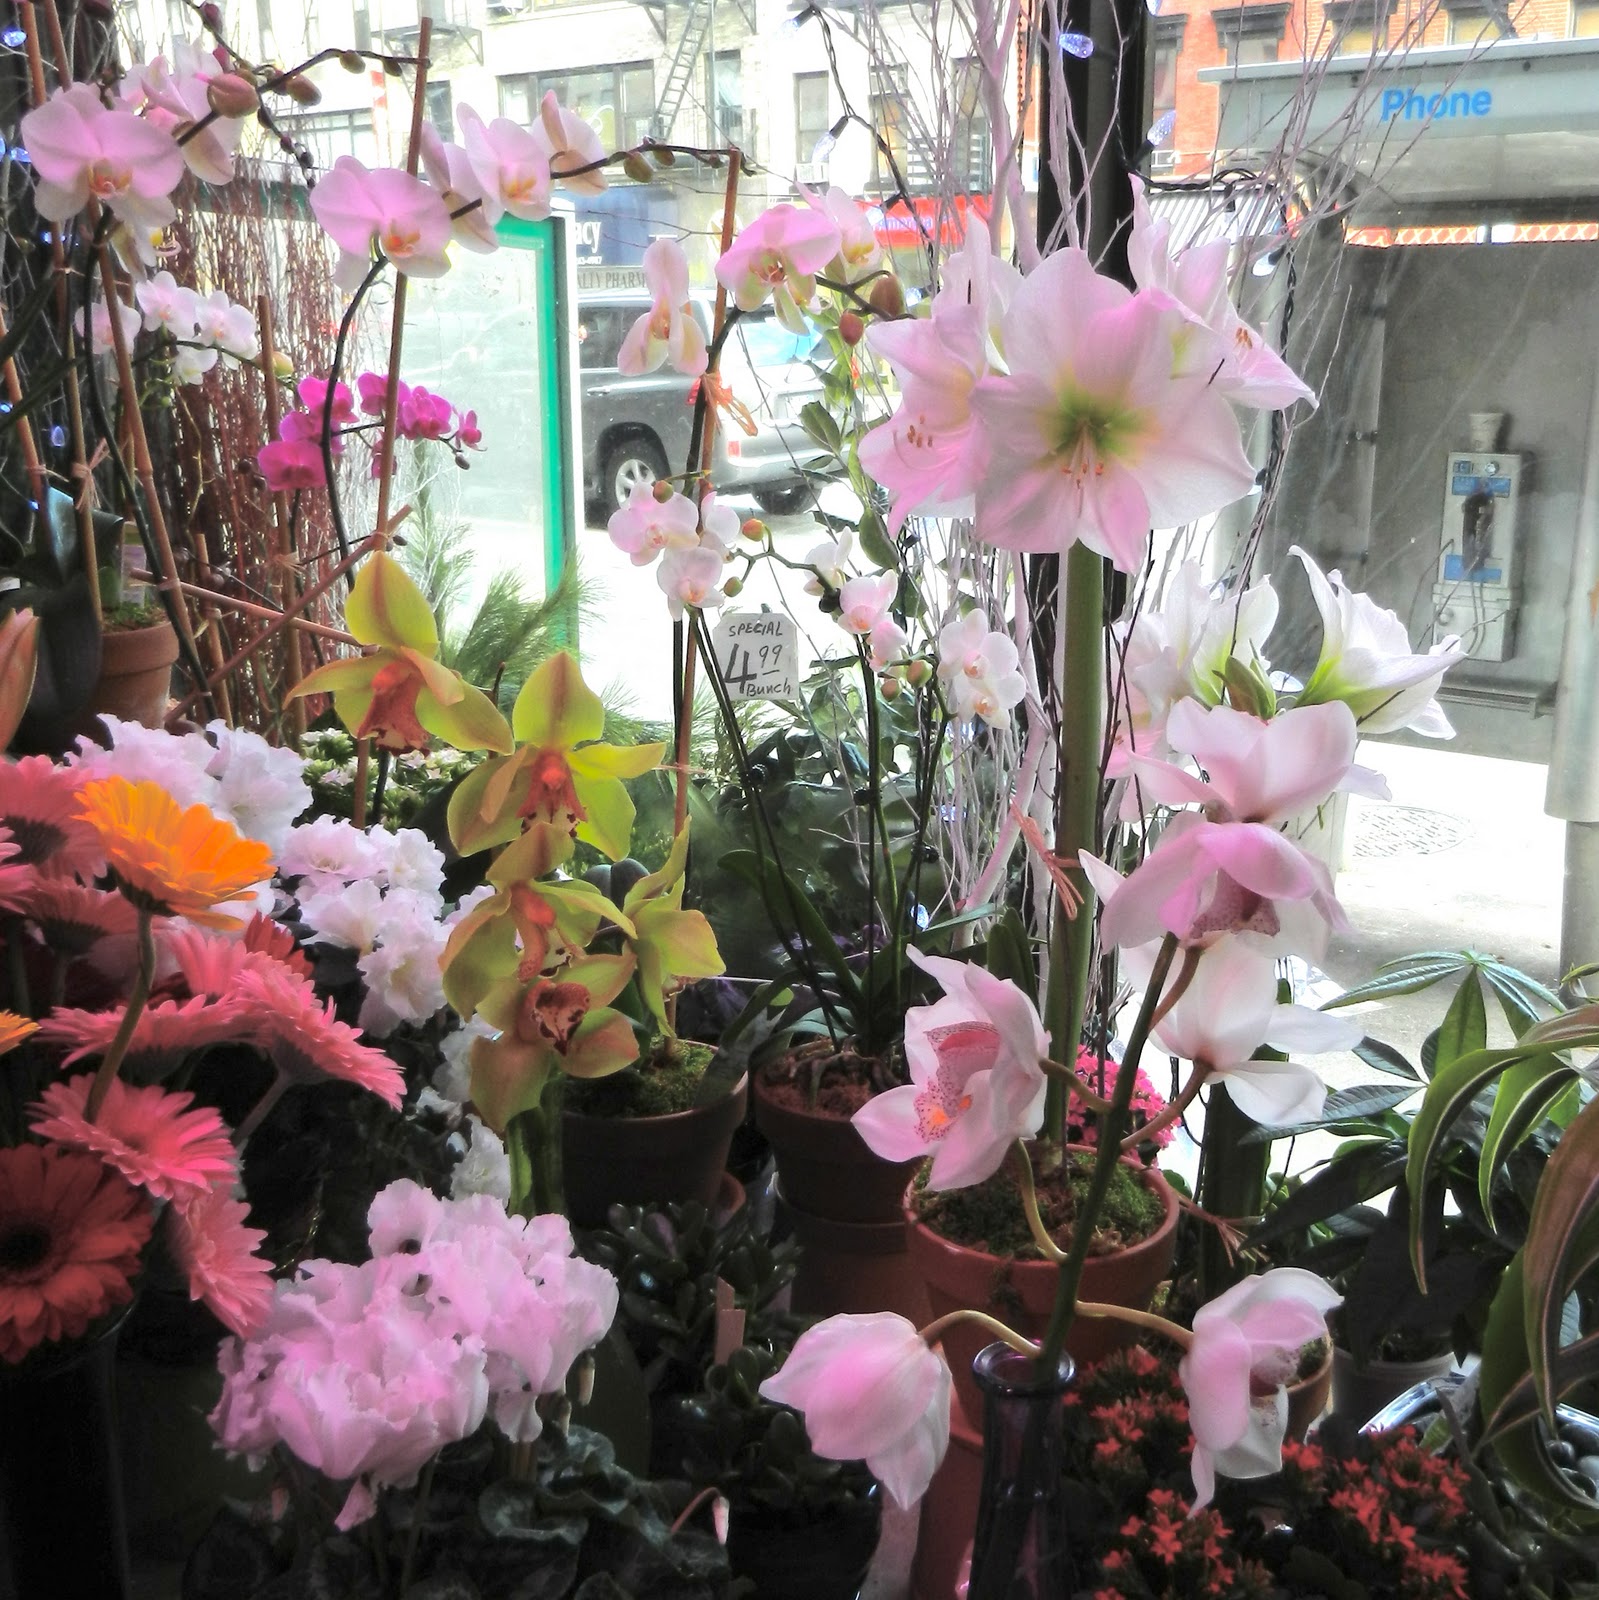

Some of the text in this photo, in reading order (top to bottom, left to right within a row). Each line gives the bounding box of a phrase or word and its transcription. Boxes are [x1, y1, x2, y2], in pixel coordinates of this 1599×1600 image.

[1381, 87, 1492, 121] Phone
[729, 621, 783, 637] SPECIAL
[746, 677, 791, 697] Bunch
